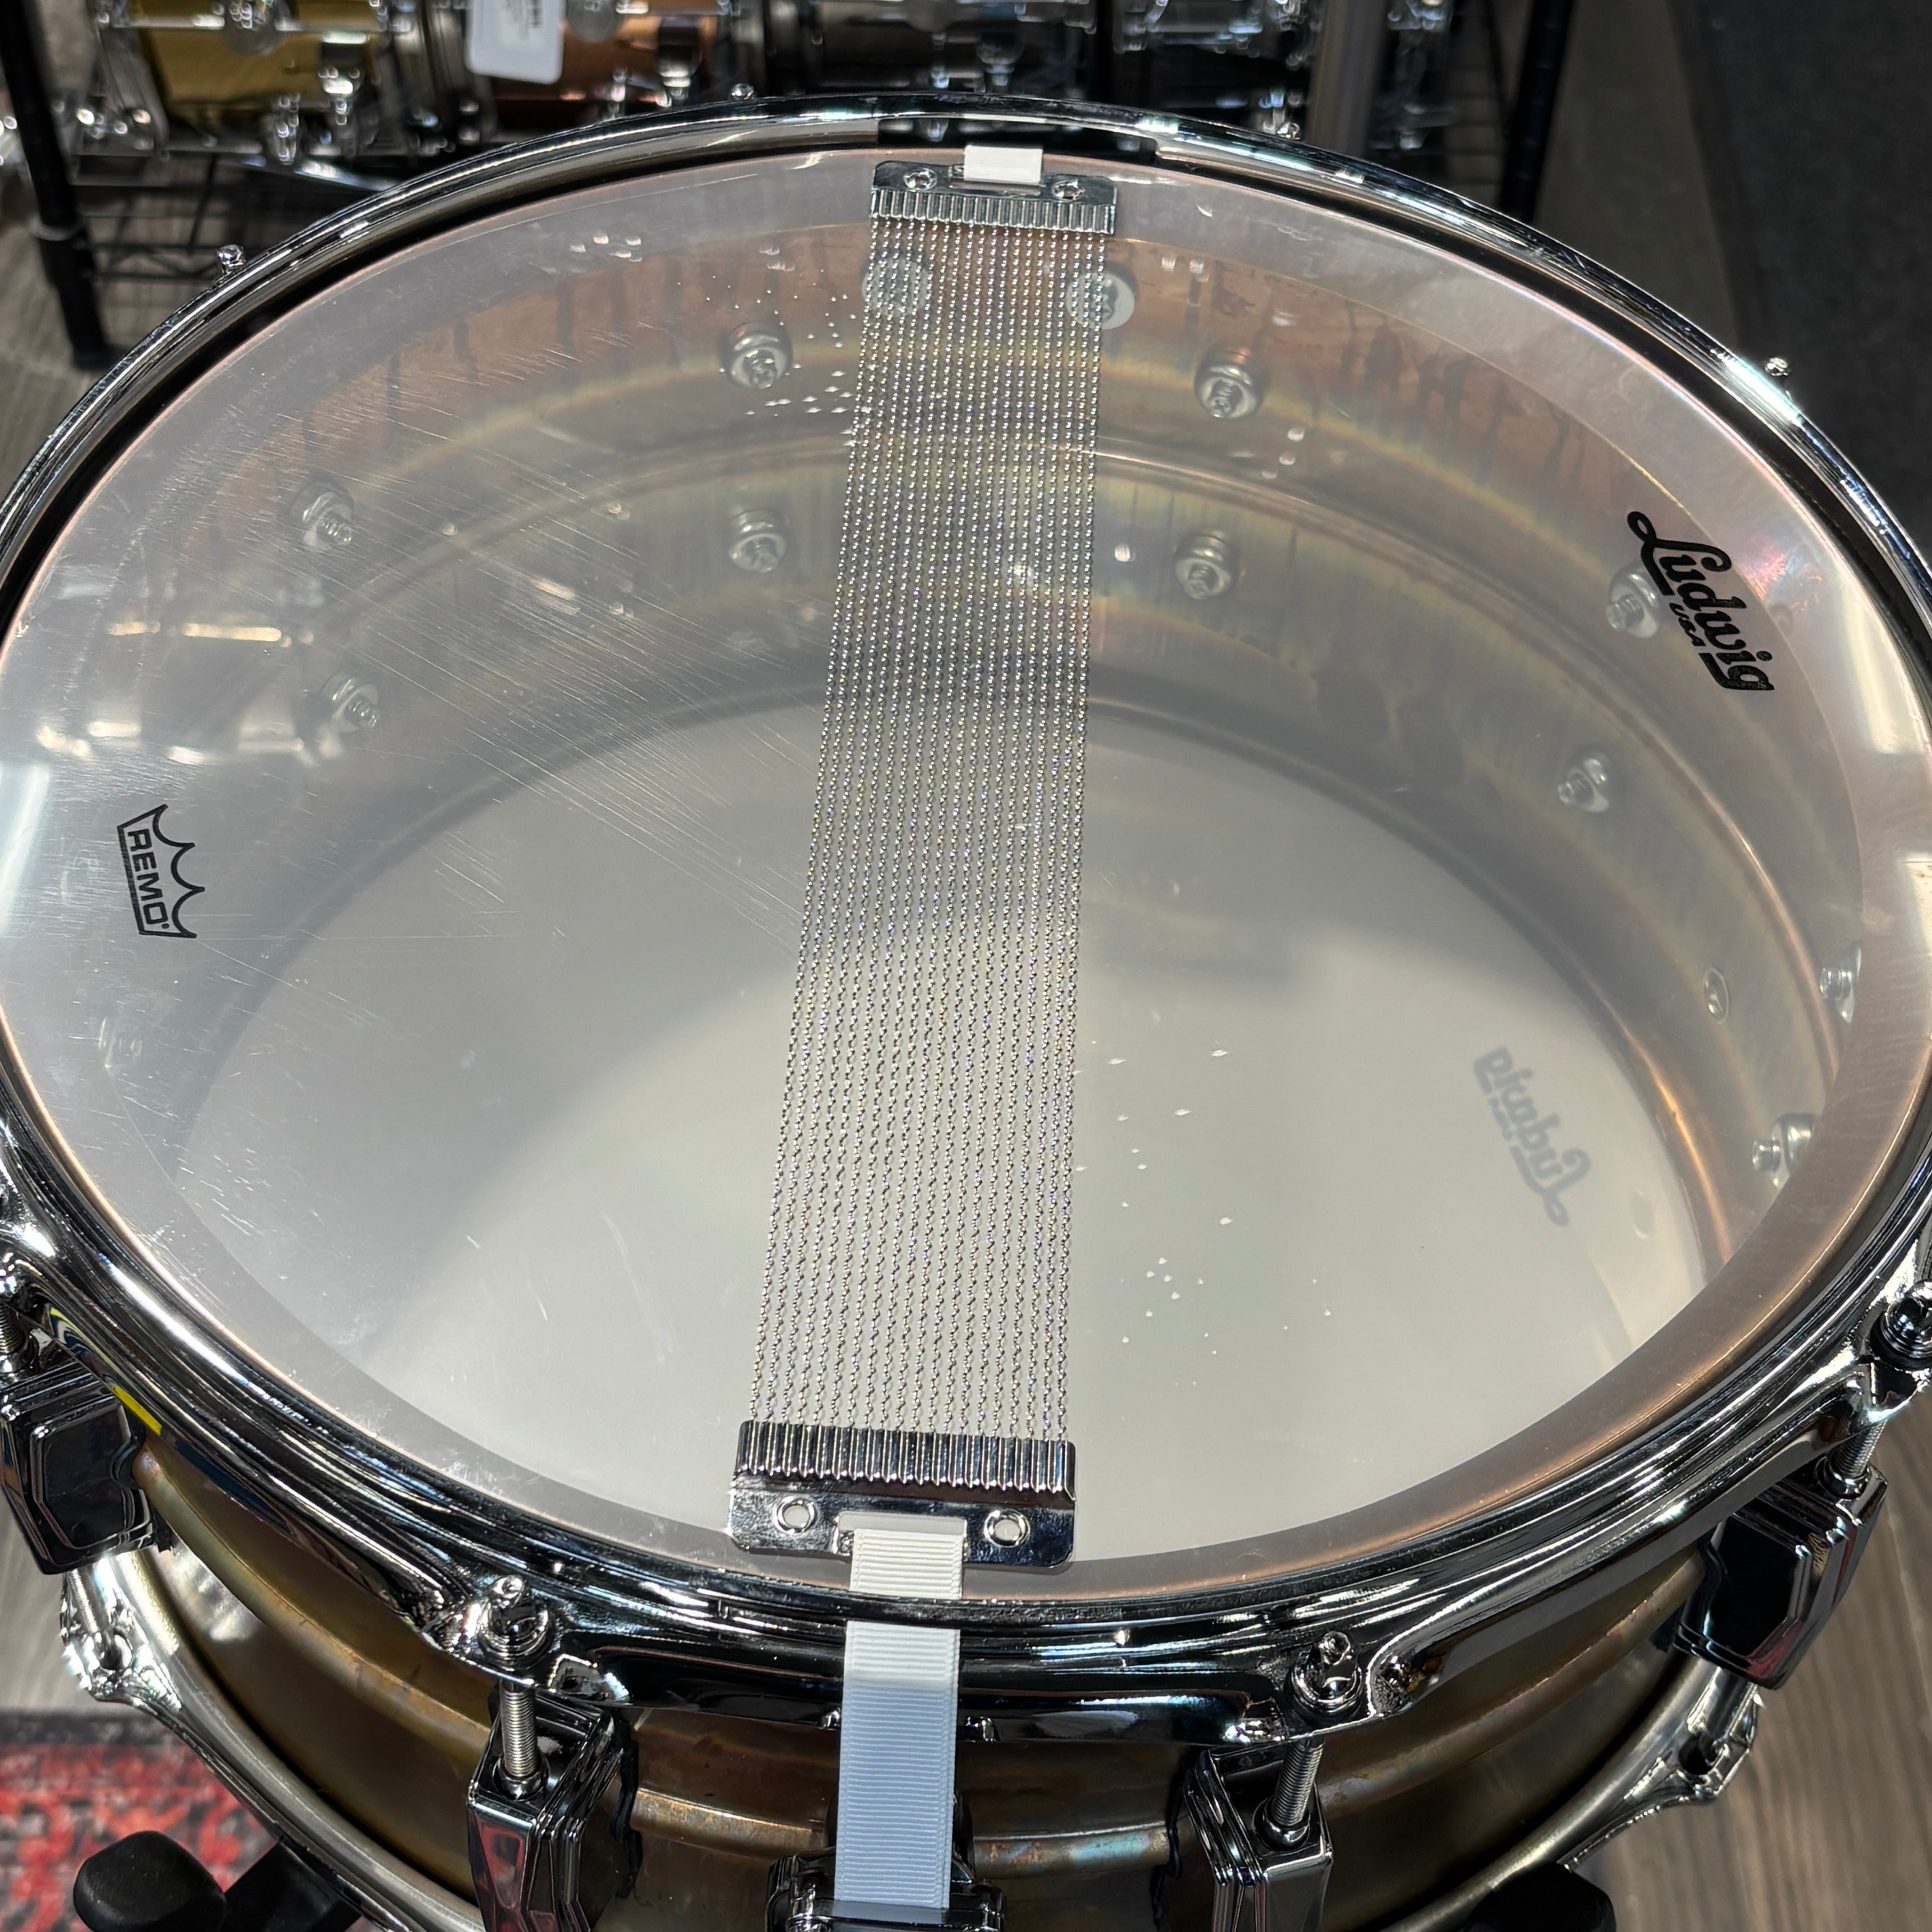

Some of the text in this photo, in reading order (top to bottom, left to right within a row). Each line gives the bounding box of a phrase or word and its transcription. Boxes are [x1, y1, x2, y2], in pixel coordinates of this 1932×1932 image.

[1627, 511, 1775, 690] Ludwig
[1669, 603, 1706, 646] USA
[127, 828, 169, 925] REMO
